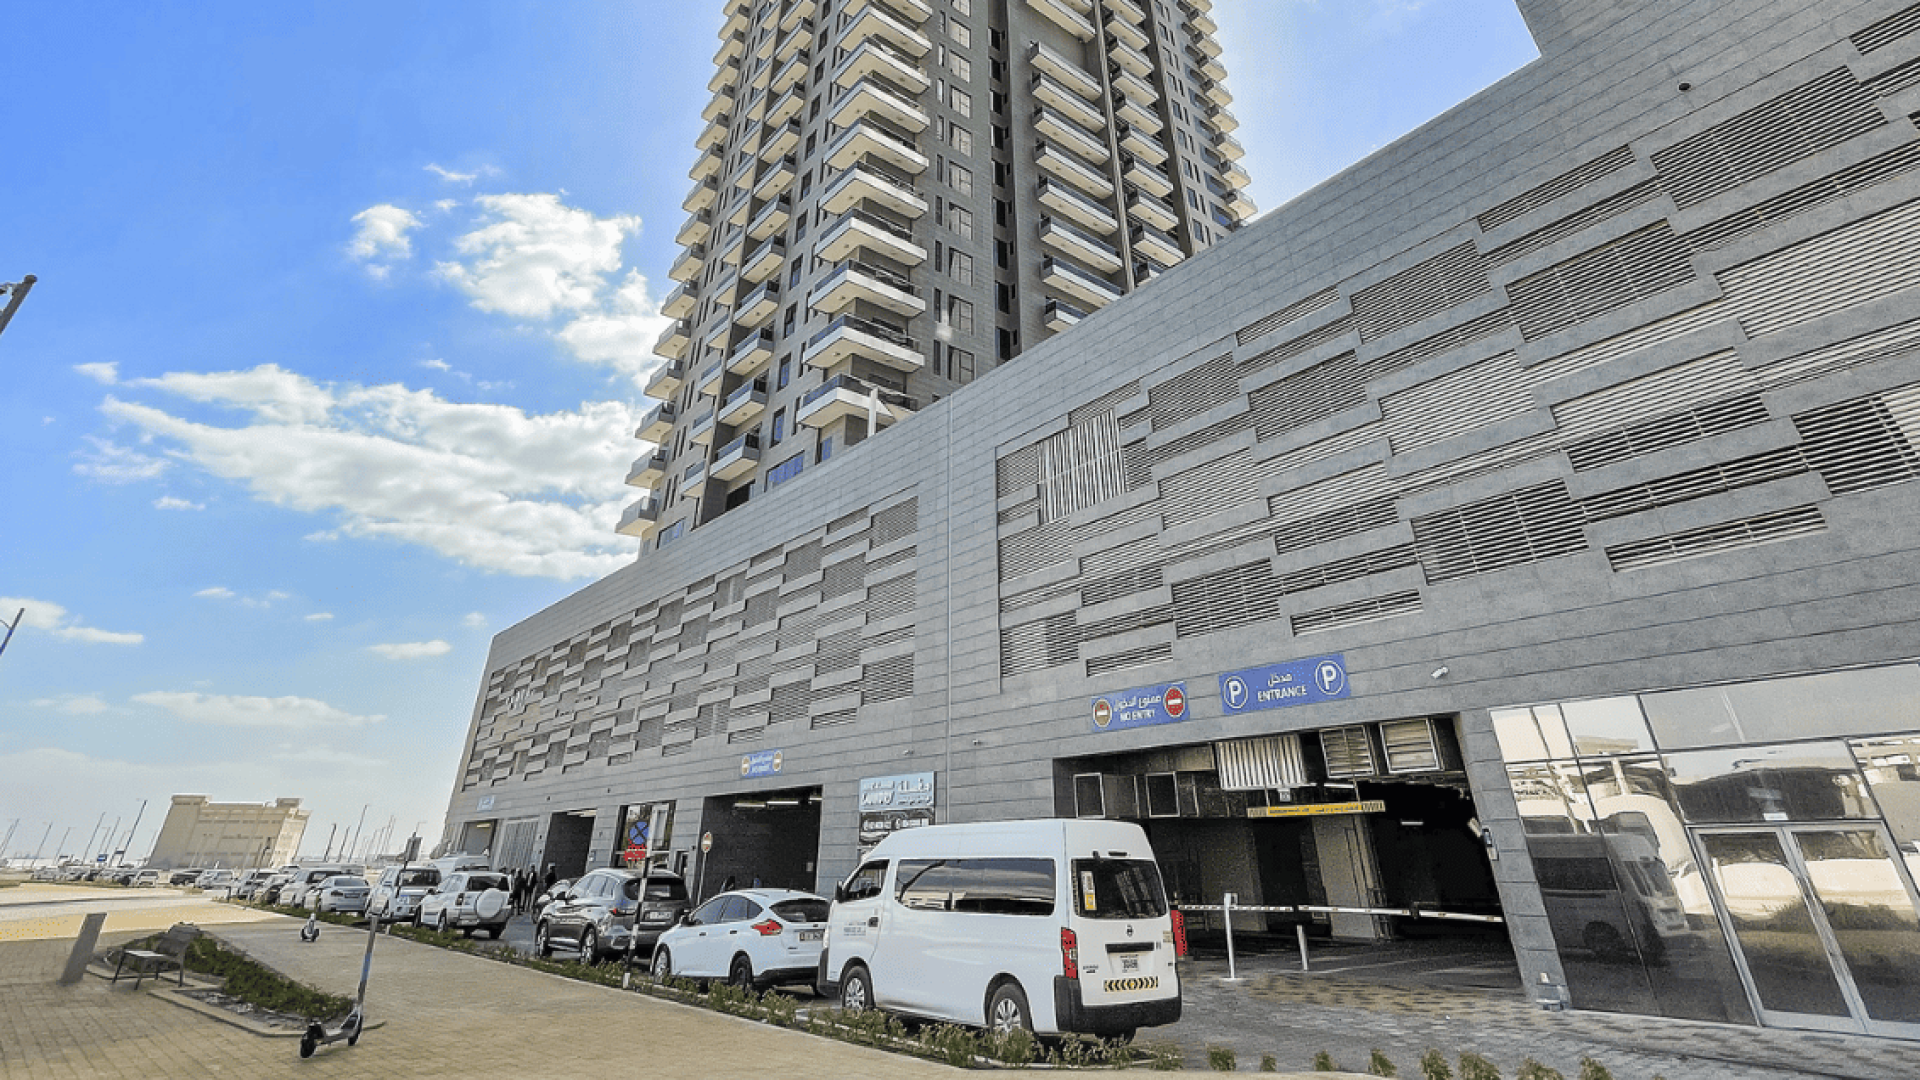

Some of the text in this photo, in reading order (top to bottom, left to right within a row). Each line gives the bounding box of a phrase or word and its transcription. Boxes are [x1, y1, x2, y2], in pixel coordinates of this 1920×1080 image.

[1267, 673, 1293, 687] مدخل
[1321, 665, 1337, 690] P
[1228, 681, 1242, 704] P
[1257, 685, 1307, 702] ENTRANCE
[1138, 694, 1162, 709] ممنوع
[1120, 709, 1155, 722] NO ENTRY
